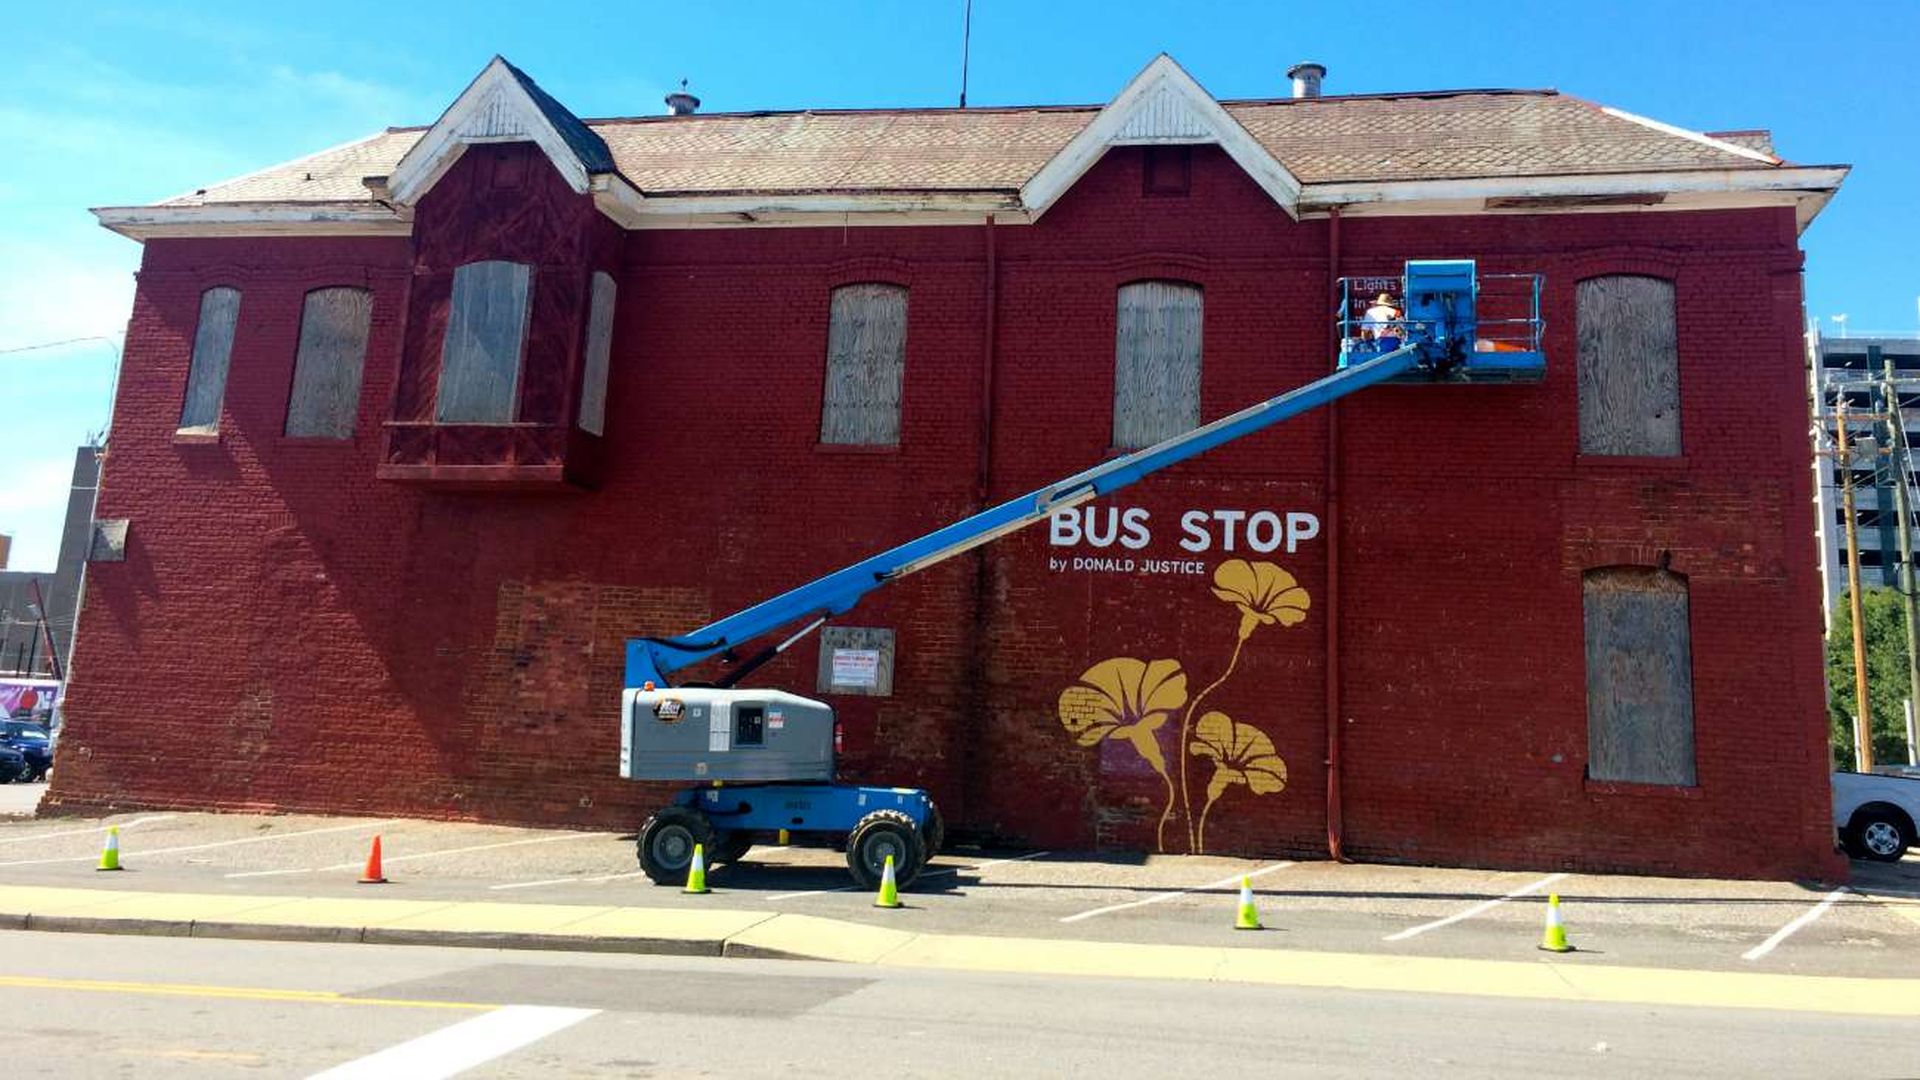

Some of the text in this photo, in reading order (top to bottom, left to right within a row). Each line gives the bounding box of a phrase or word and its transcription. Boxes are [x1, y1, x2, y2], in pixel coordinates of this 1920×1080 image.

[1353, 278, 1397, 294] Lights
[1050, 506, 1320, 553] BUS STOP
[1050, 557, 1206, 574] by DONALD JUSTICE
